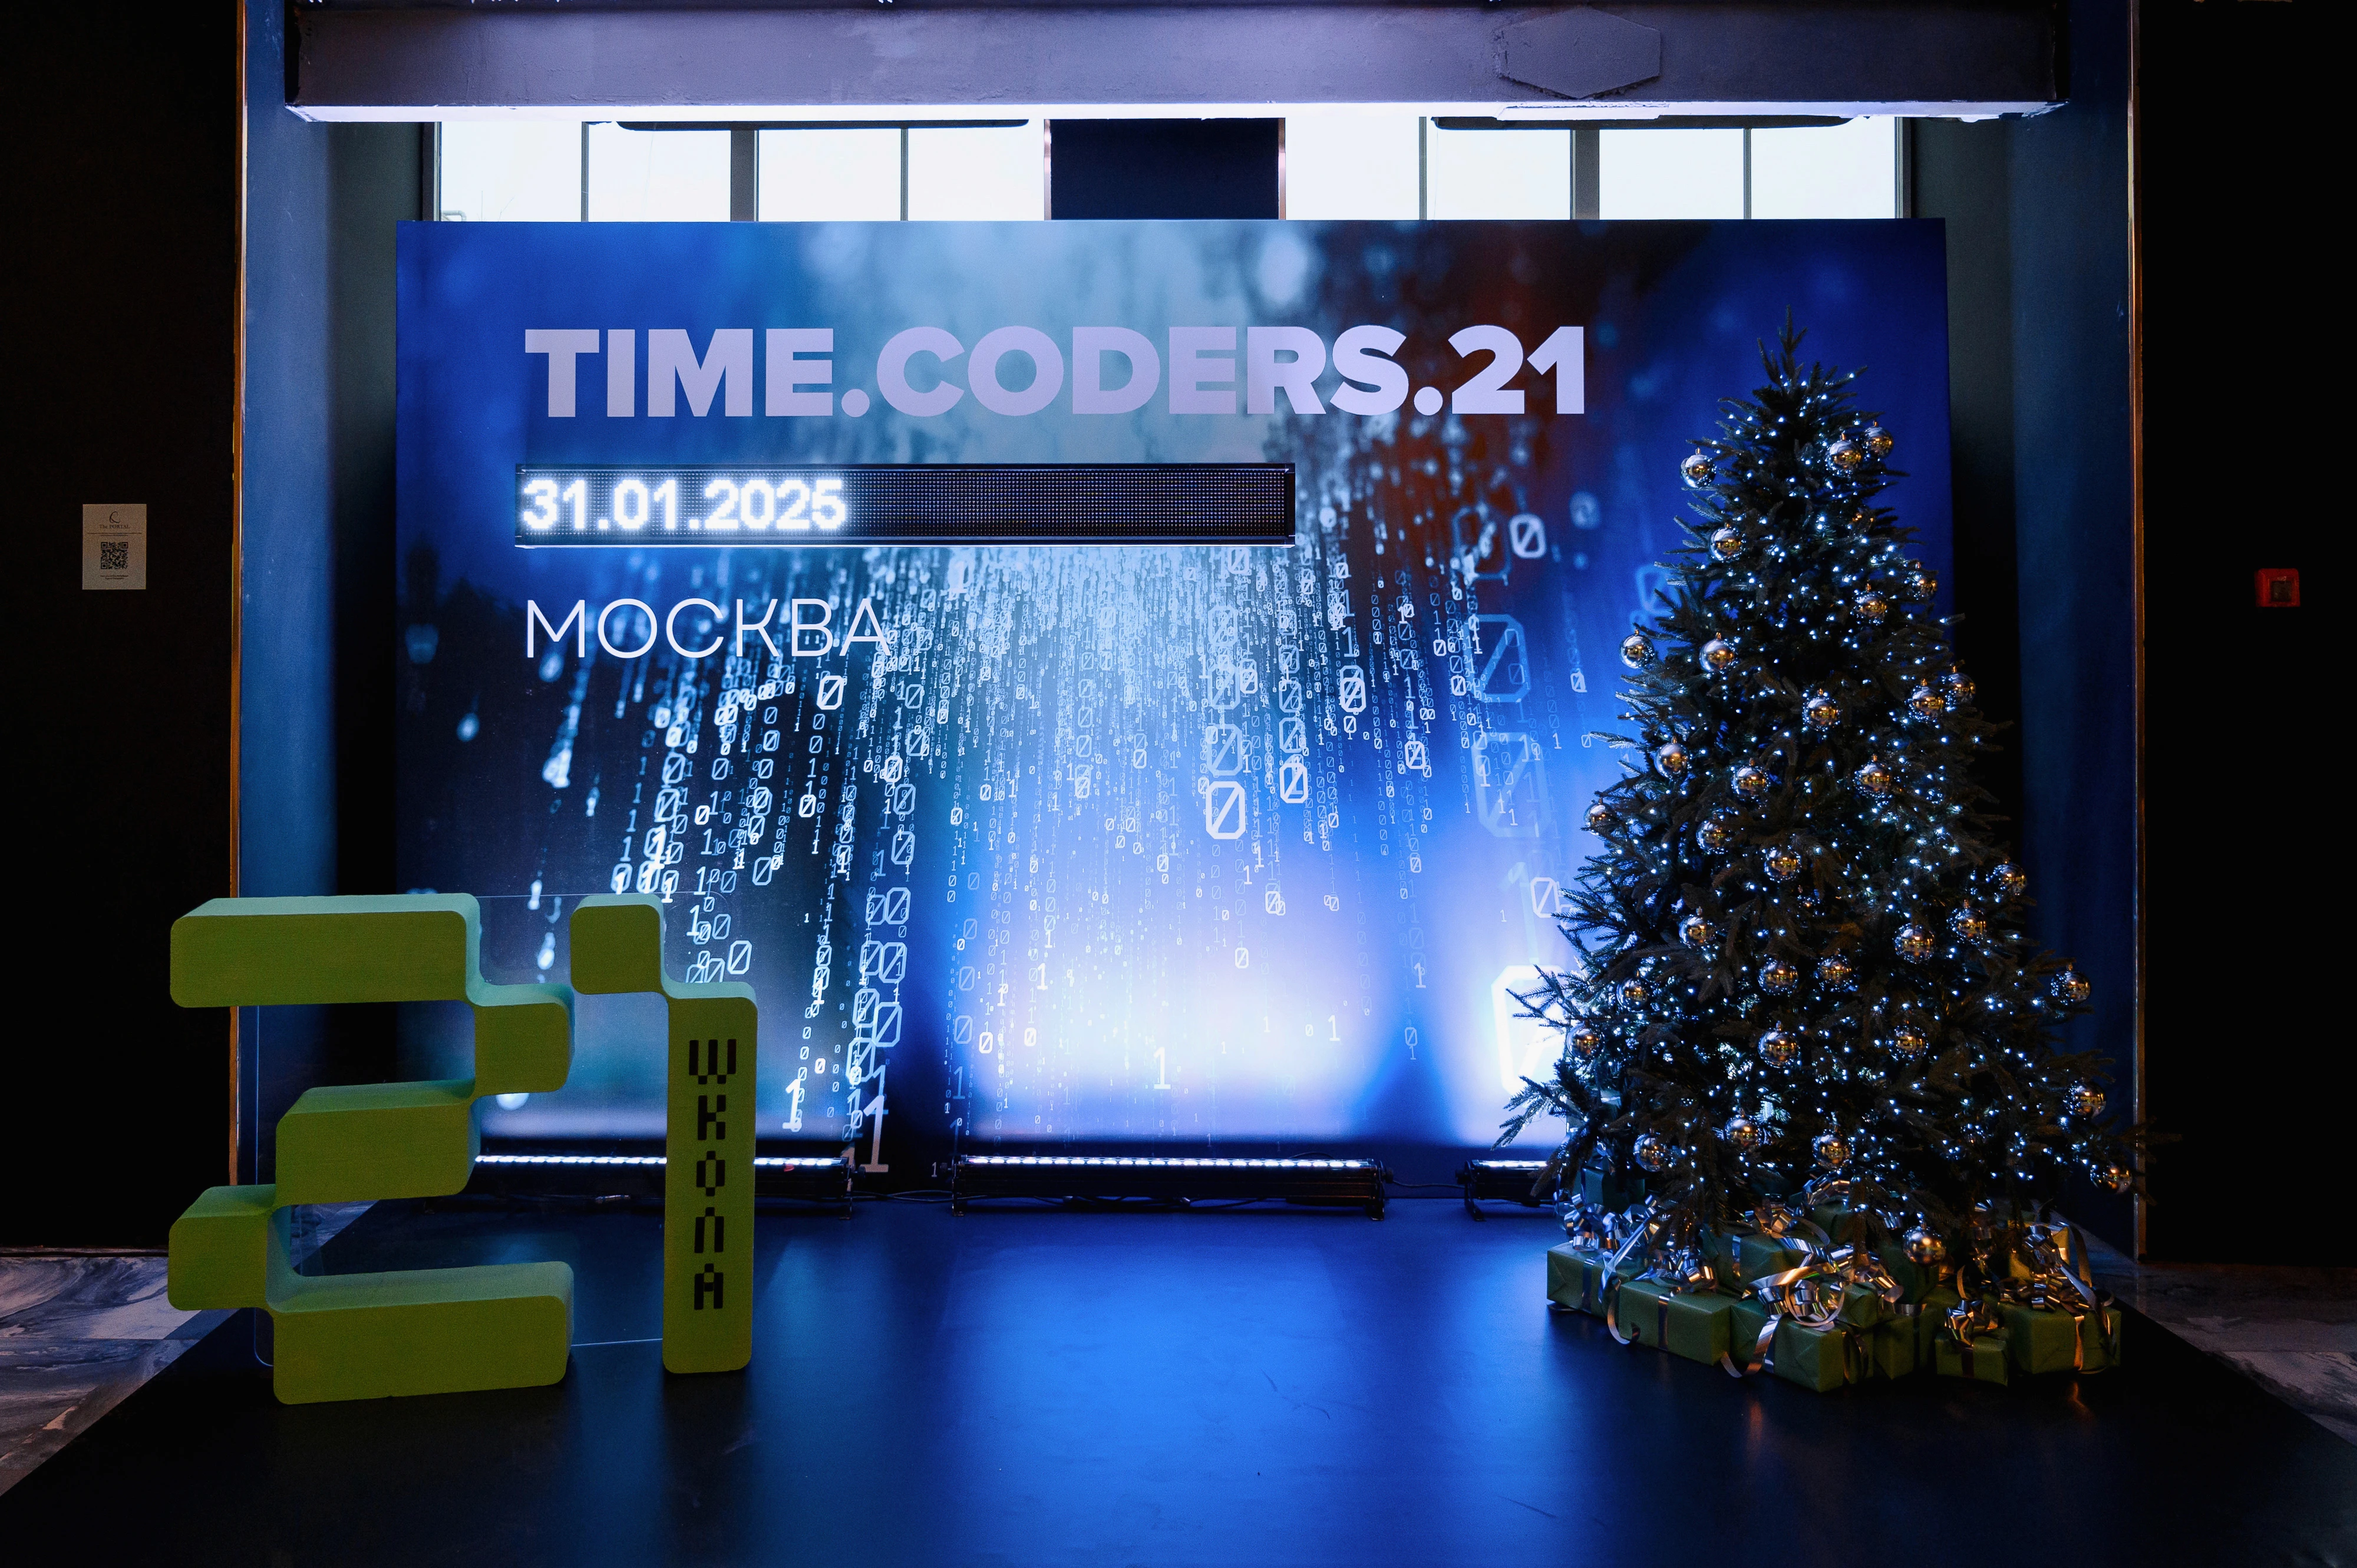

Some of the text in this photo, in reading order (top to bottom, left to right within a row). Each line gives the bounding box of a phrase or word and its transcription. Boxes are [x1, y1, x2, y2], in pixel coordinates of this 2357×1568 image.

[525, 325, 1584, 417] TIME.CODERS.21
[523, 478, 846, 530] 31.01.2025
[527, 598, 891, 658] МОСКВА
[688, 1039, 737, 1310] ШКОЛА
